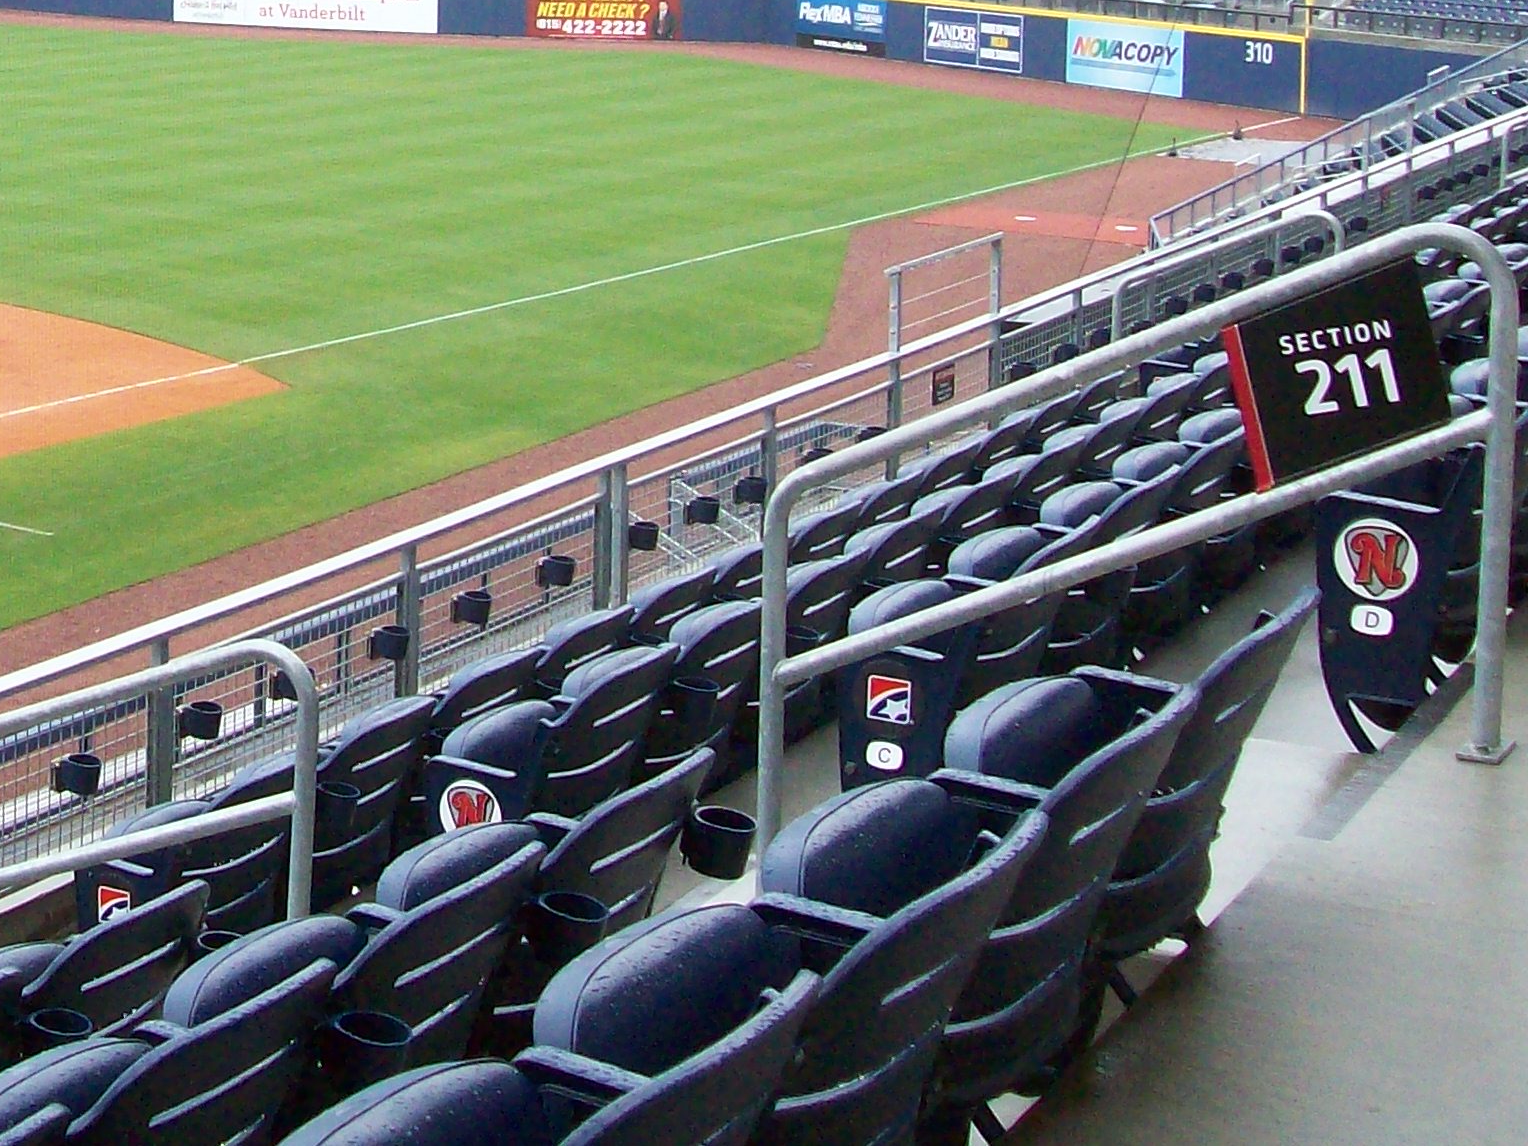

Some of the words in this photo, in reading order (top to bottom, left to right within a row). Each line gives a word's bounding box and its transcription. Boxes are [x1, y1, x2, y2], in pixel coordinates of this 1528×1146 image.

[259, 6, 273, 18] at
[279, 3, 366, 21] Vanderbilt
[536, 1, 575, 18] NEED
[575, 2, 587, 18] A
[562, 19, 647, 35] 422-2222
[927, 21, 976, 46] ZANDER
[1073, 36, 1180, 66] NOVACOPY
[1244, 41, 1273, 64] 310
[1278, 319, 1393, 355] SECTION
[1294, 348, 1401, 416] 211
[1350, 532, 1407, 590] N
[1364, 611, 1380, 629] D
[878, 747, 892, 763] C
